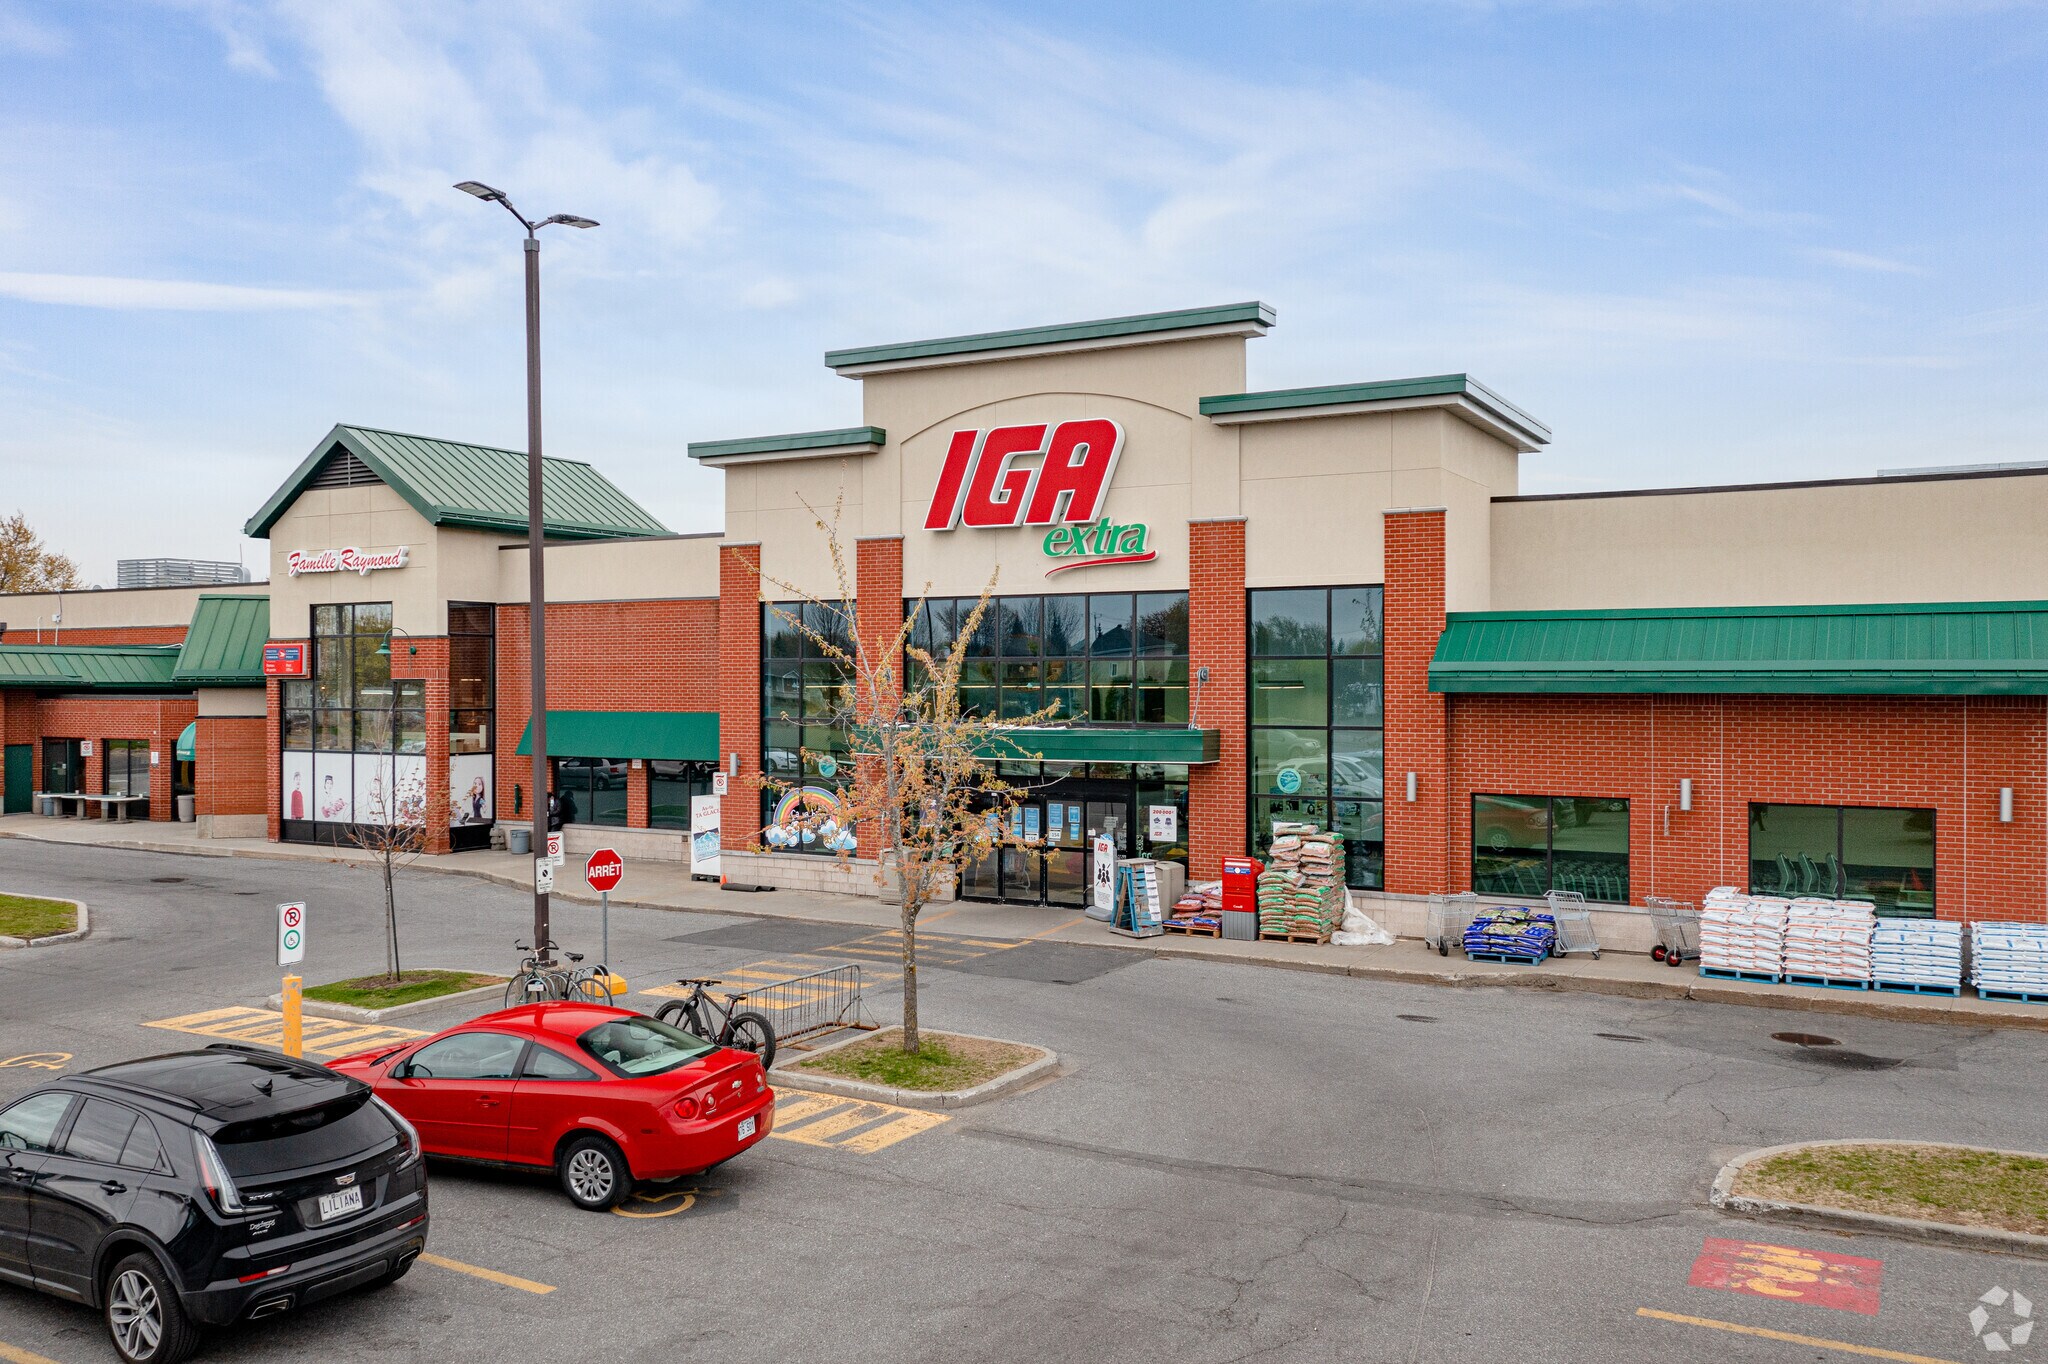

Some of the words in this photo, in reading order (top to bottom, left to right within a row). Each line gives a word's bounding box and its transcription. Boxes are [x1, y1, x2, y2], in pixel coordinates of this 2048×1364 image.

[923, 418, 1122, 531] IGA
[1042, 517, 1149, 557] extra
[289, 551, 336, 575] Famille
[340, 548, 403, 573] Raymond
[1097, 842, 1109, 853] IGA
[588, 861, 622, 879] ARRÊT
[321, 1191, 361, 1214] LILIANA
